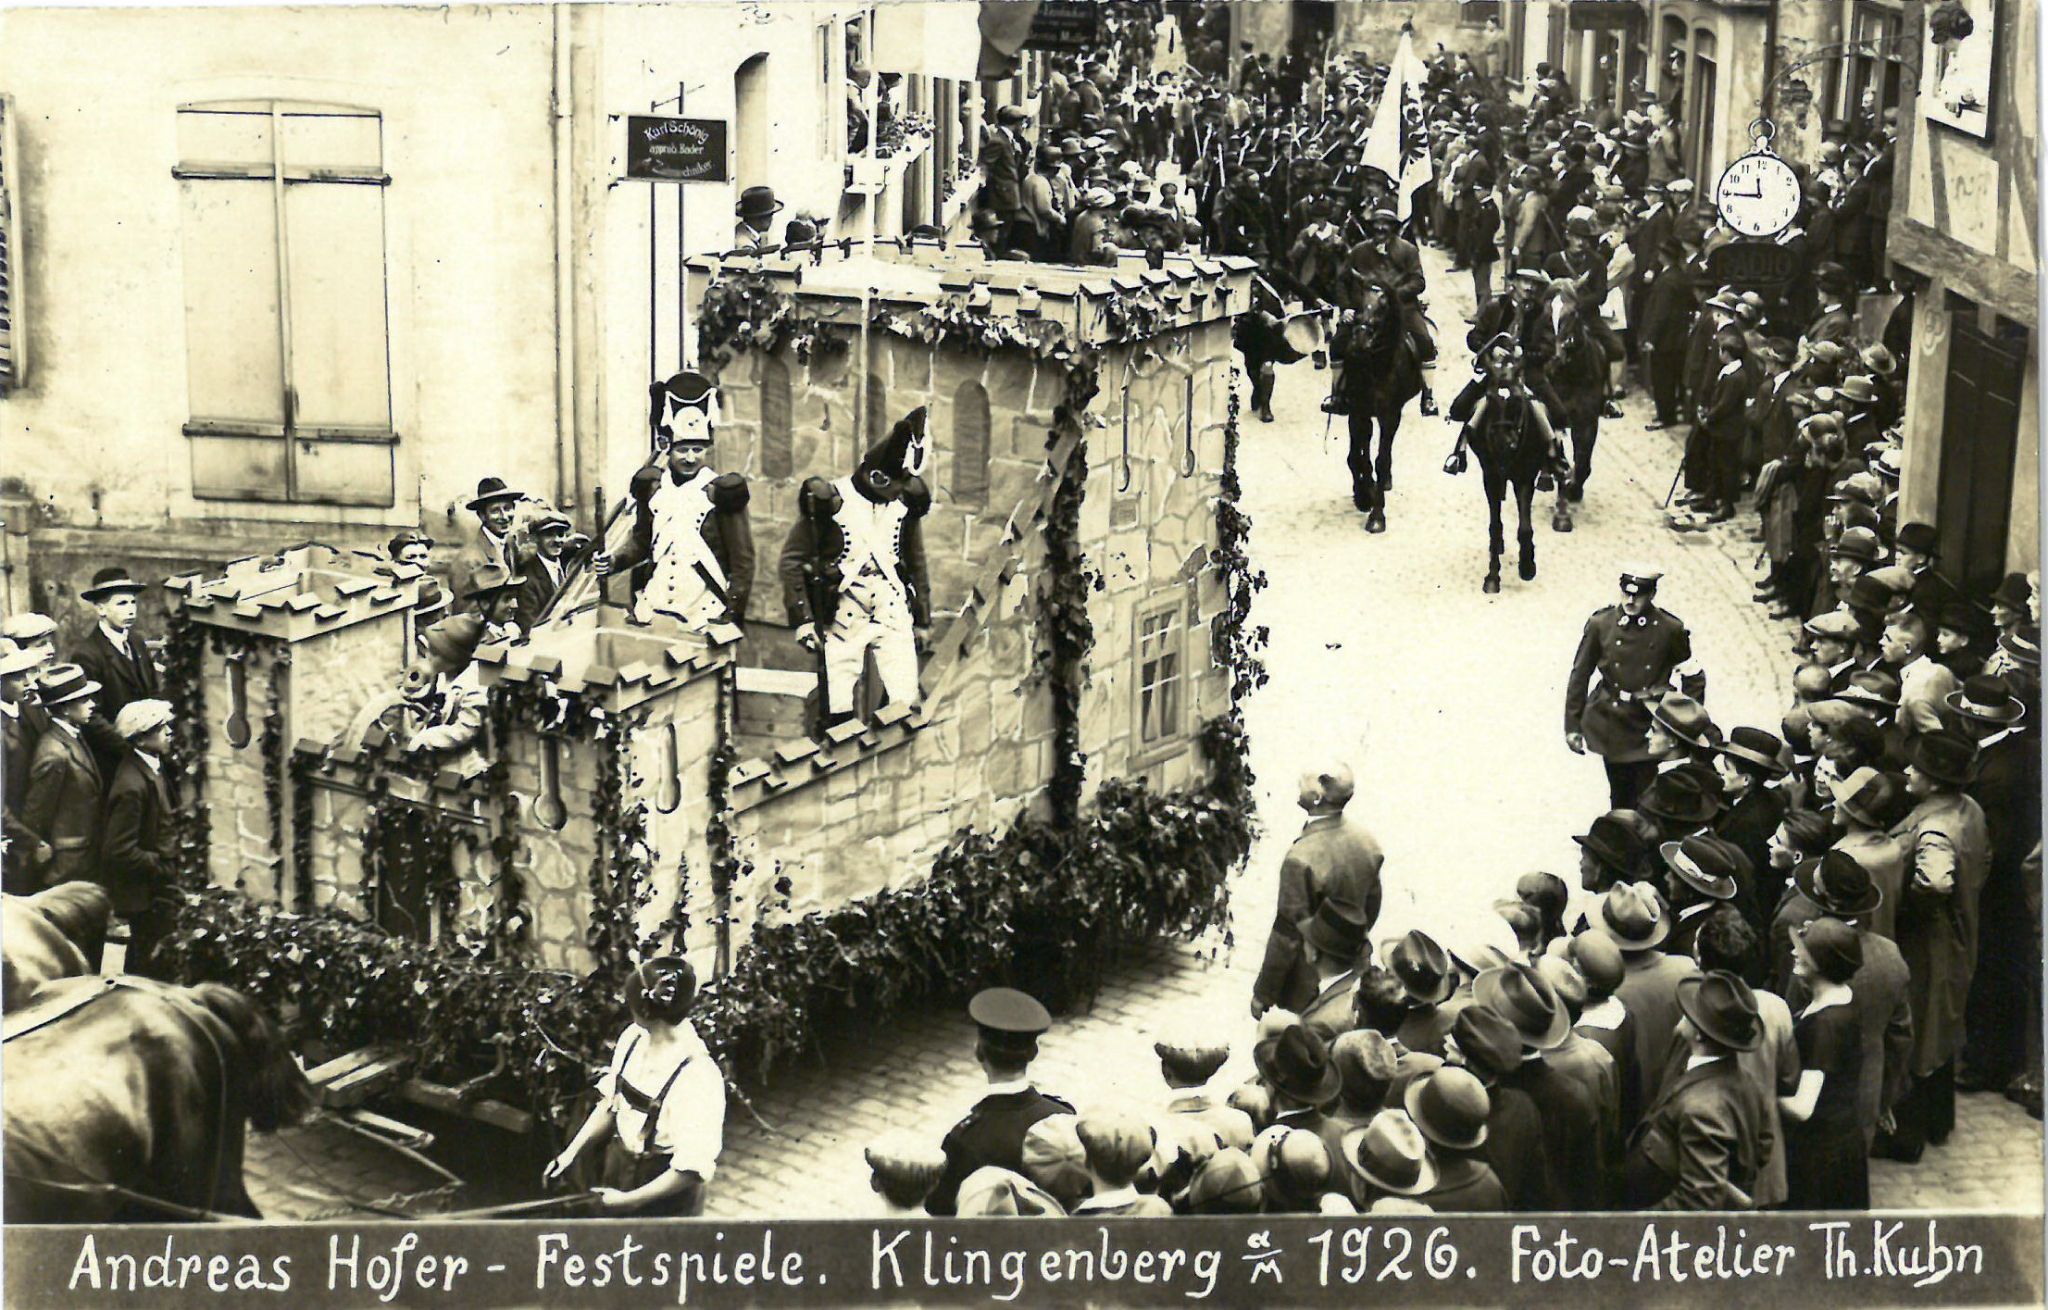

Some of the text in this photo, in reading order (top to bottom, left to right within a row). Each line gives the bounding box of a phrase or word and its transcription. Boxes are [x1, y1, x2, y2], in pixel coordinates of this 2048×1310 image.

[1741, 164, 1750, 174] 11
[1757, 160, 1768, 170] 12
[1776, 165, 1781, 175] 1
[1730, 174, 1740, 184] 10
[1786, 176, 1793, 187] 2
[1722, 188, 1732, 198] 9
[1726, 204, 1733, 214] 8
[1753, 222, 1760, 232] 6
[1715, 251, 1792, 276] RADIO
